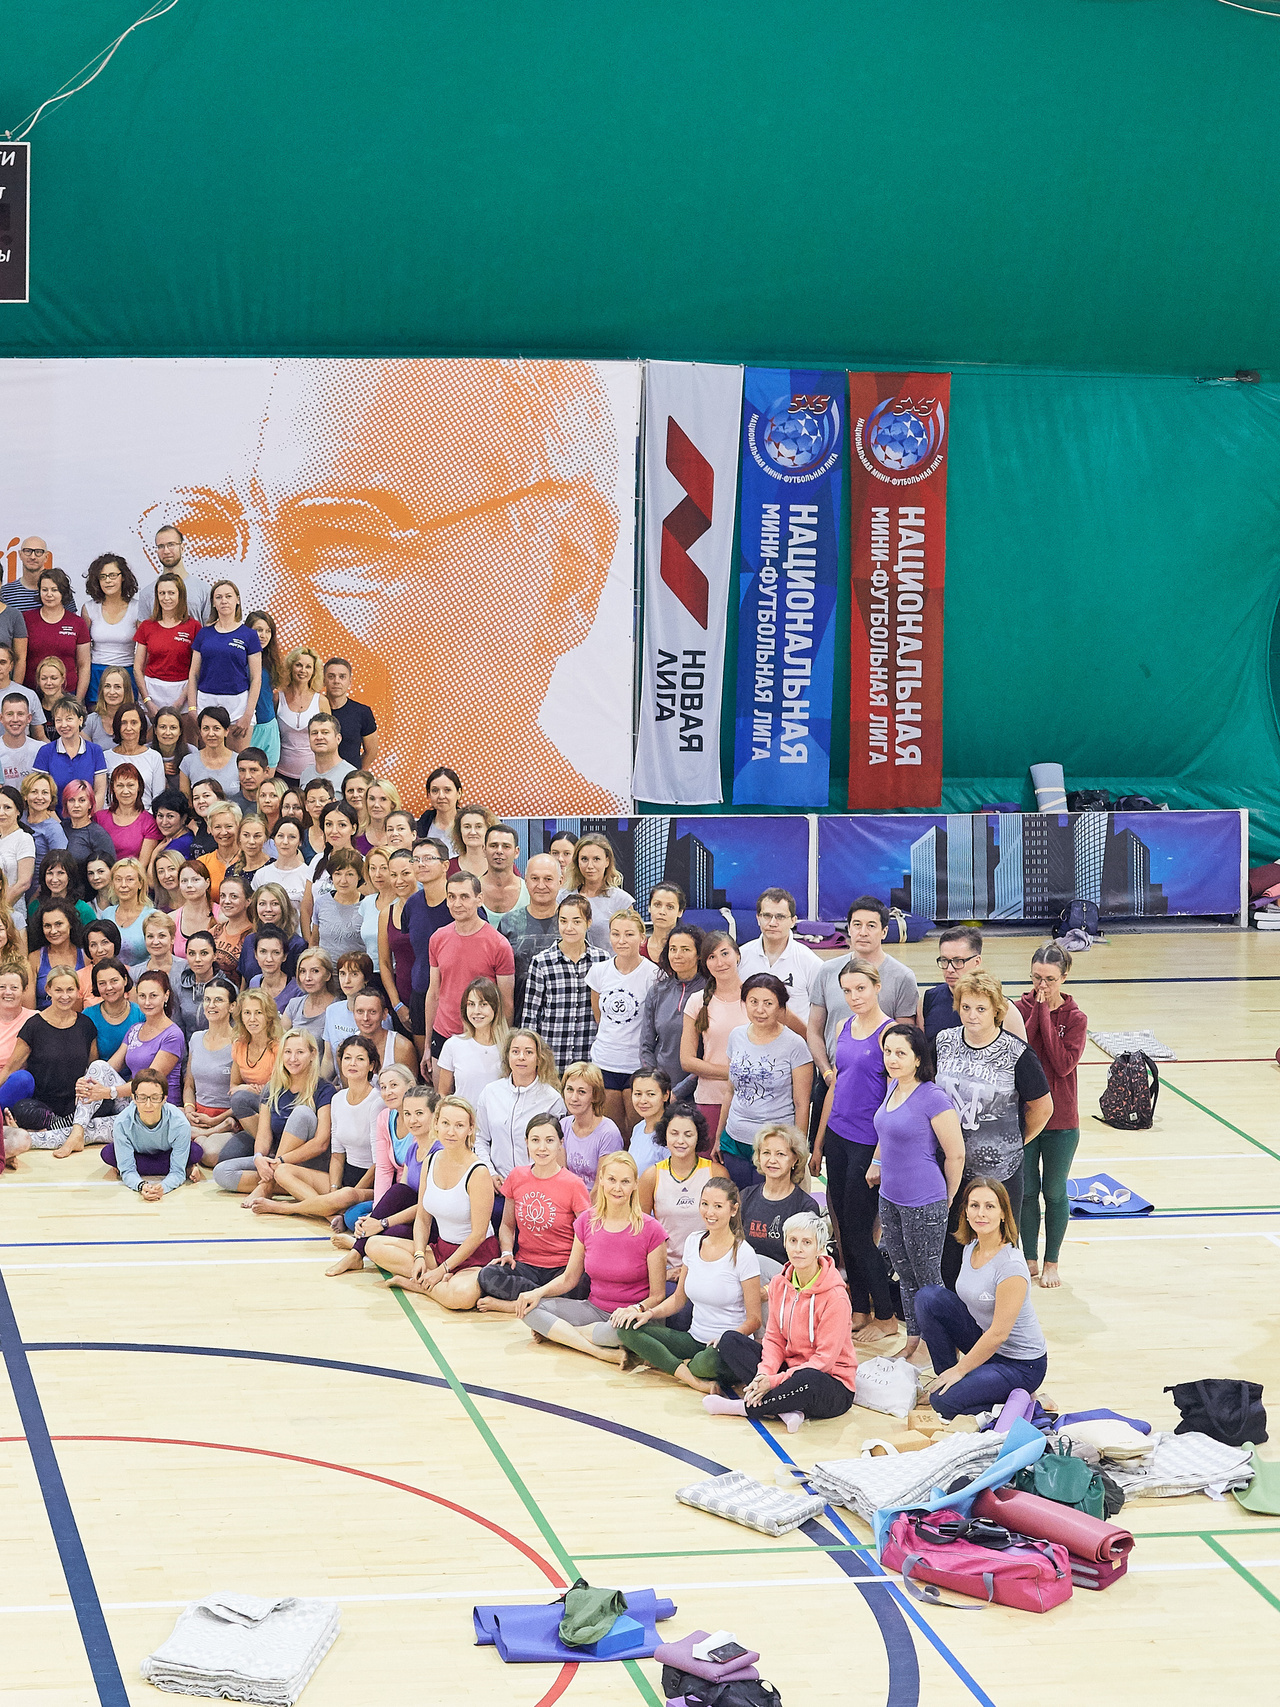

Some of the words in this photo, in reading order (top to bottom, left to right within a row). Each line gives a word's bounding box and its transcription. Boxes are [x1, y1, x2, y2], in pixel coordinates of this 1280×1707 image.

[754, 503, 781, 703] МИНИ-ФУТБОЛЬНАЯ
[780, 503, 819, 764] НАЦИОНАЛЬНАЯ
[869, 507, 890, 706] МИНИ-ФУТБОЛЬНАЯ
[892, 506, 926, 767] НАЦИОНАЛЬНАЯ
[655, 648, 677, 722] ЛИГА
[680, 650, 707, 753] НОВАЯ
[751, 708, 773, 761] ЛИГА
[869, 712, 890, 765] ЛИГА
